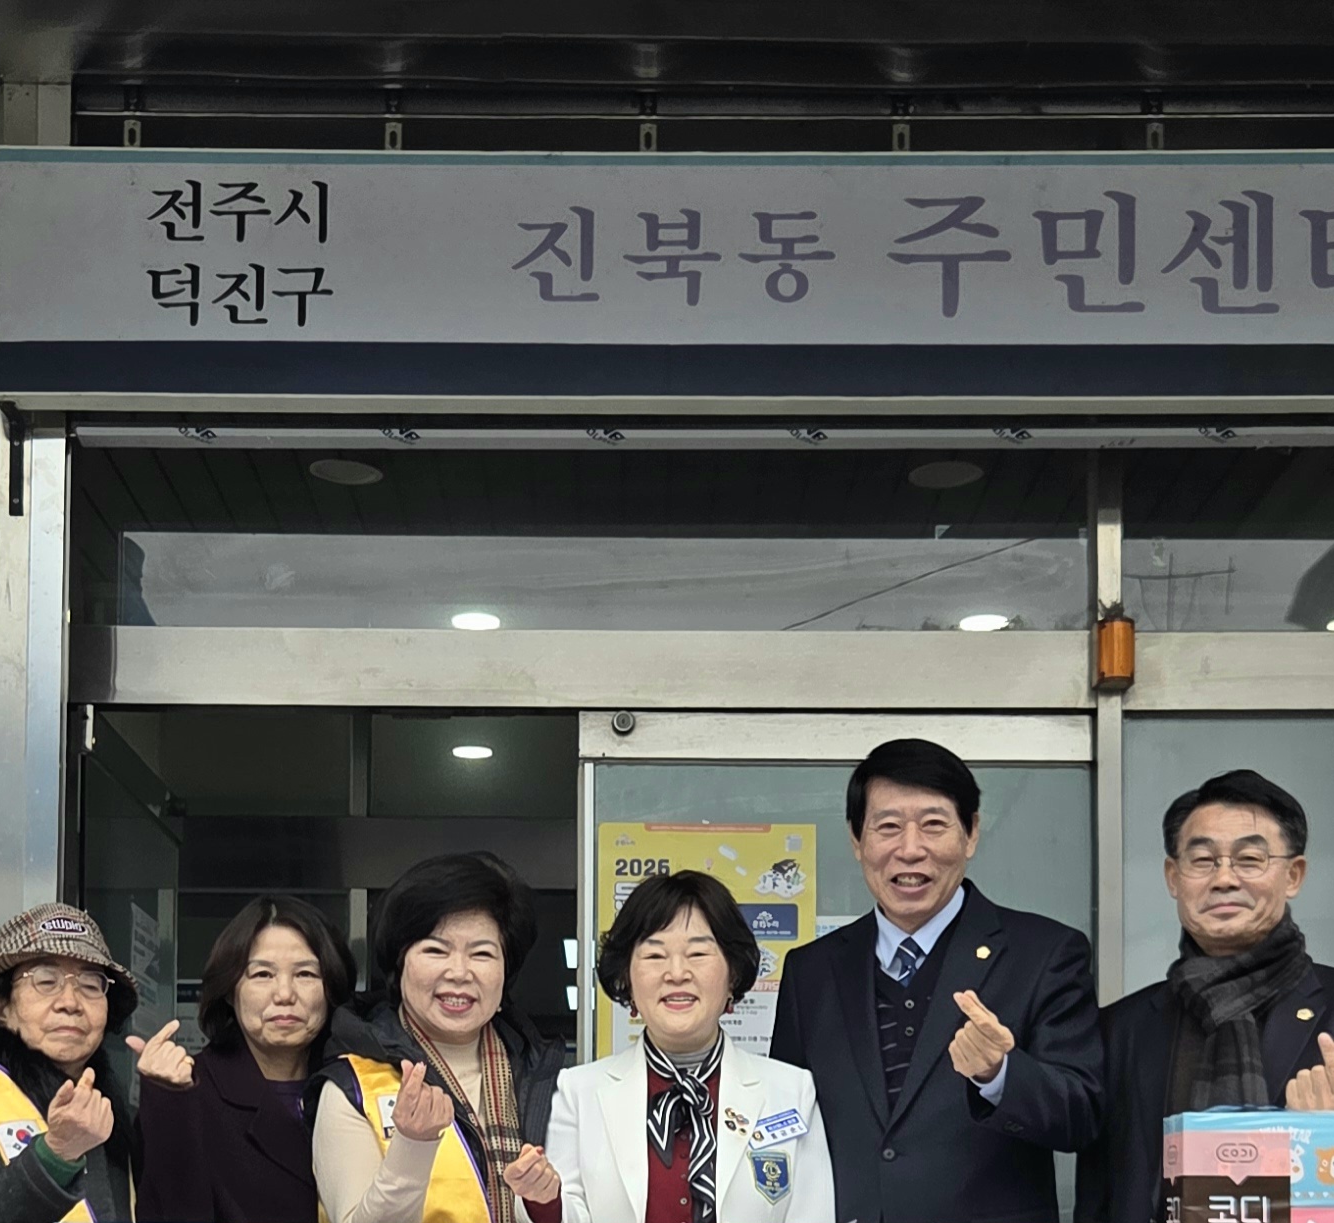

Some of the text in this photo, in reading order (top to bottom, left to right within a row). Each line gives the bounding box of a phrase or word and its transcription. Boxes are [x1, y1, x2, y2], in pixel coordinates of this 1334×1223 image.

[146, 179, 329, 243] 전주시
[511, 205, 836, 305] 진북동
[146, 263, 334, 327] 덕진구
